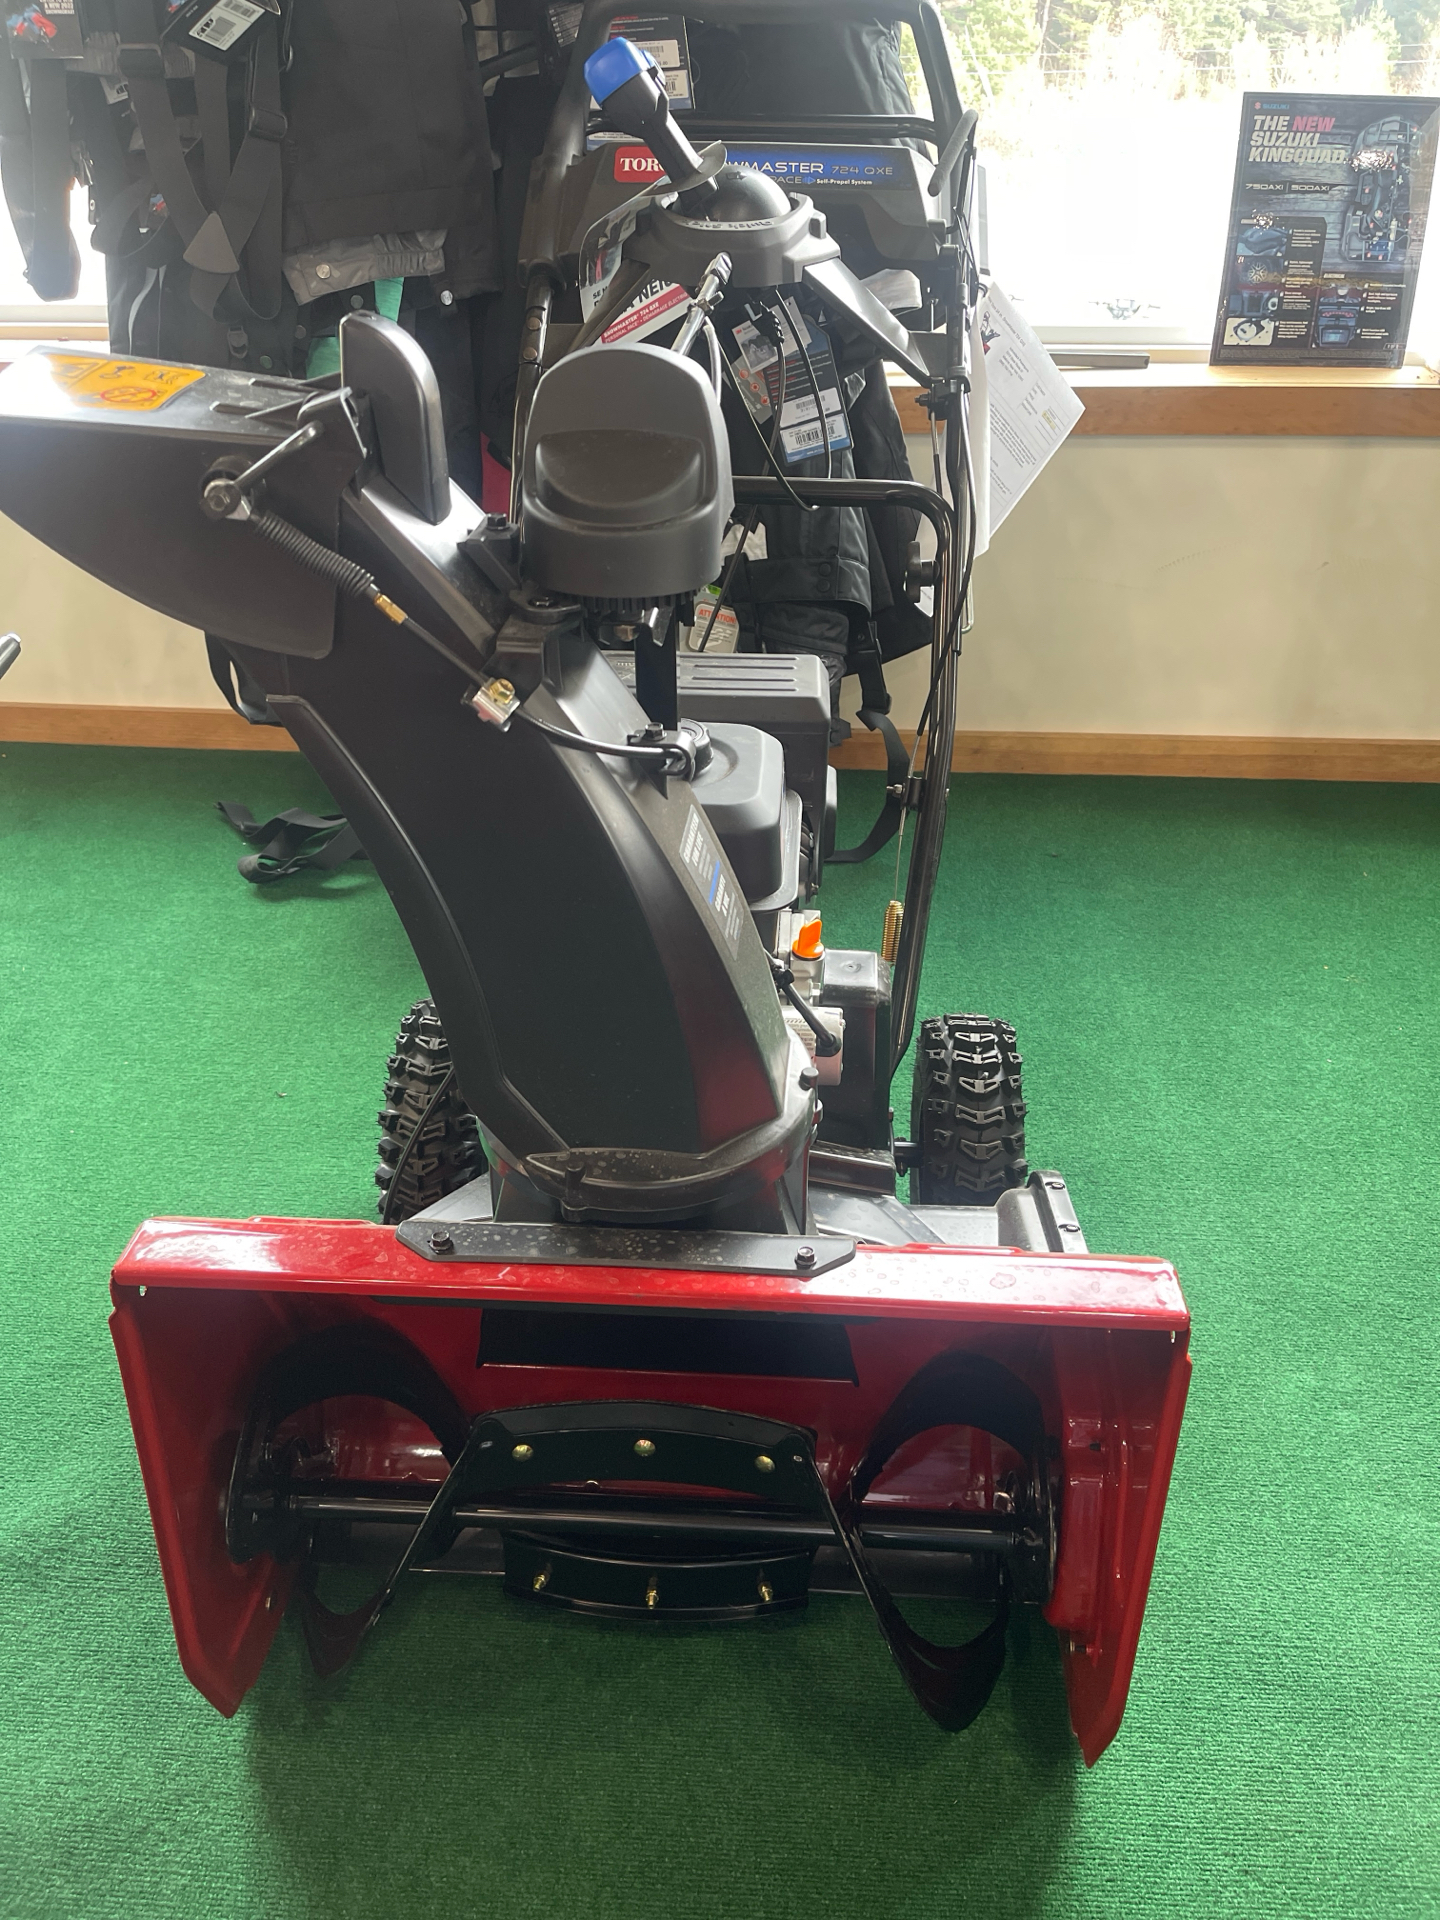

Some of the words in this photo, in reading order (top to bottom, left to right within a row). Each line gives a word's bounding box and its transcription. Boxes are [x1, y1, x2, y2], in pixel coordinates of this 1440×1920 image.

[1253, 115, 1290, 131] THE
[1292, 115, 1336, 132] NEW
[1250, 131, 1320, 148] SUZUKI
[620, 157, 665, 172] TOR
[1248, 147, 1346, 166] KINGQUAD
[832, 165, 860, 175] 724
[864, 166, 893, 175] QXE
